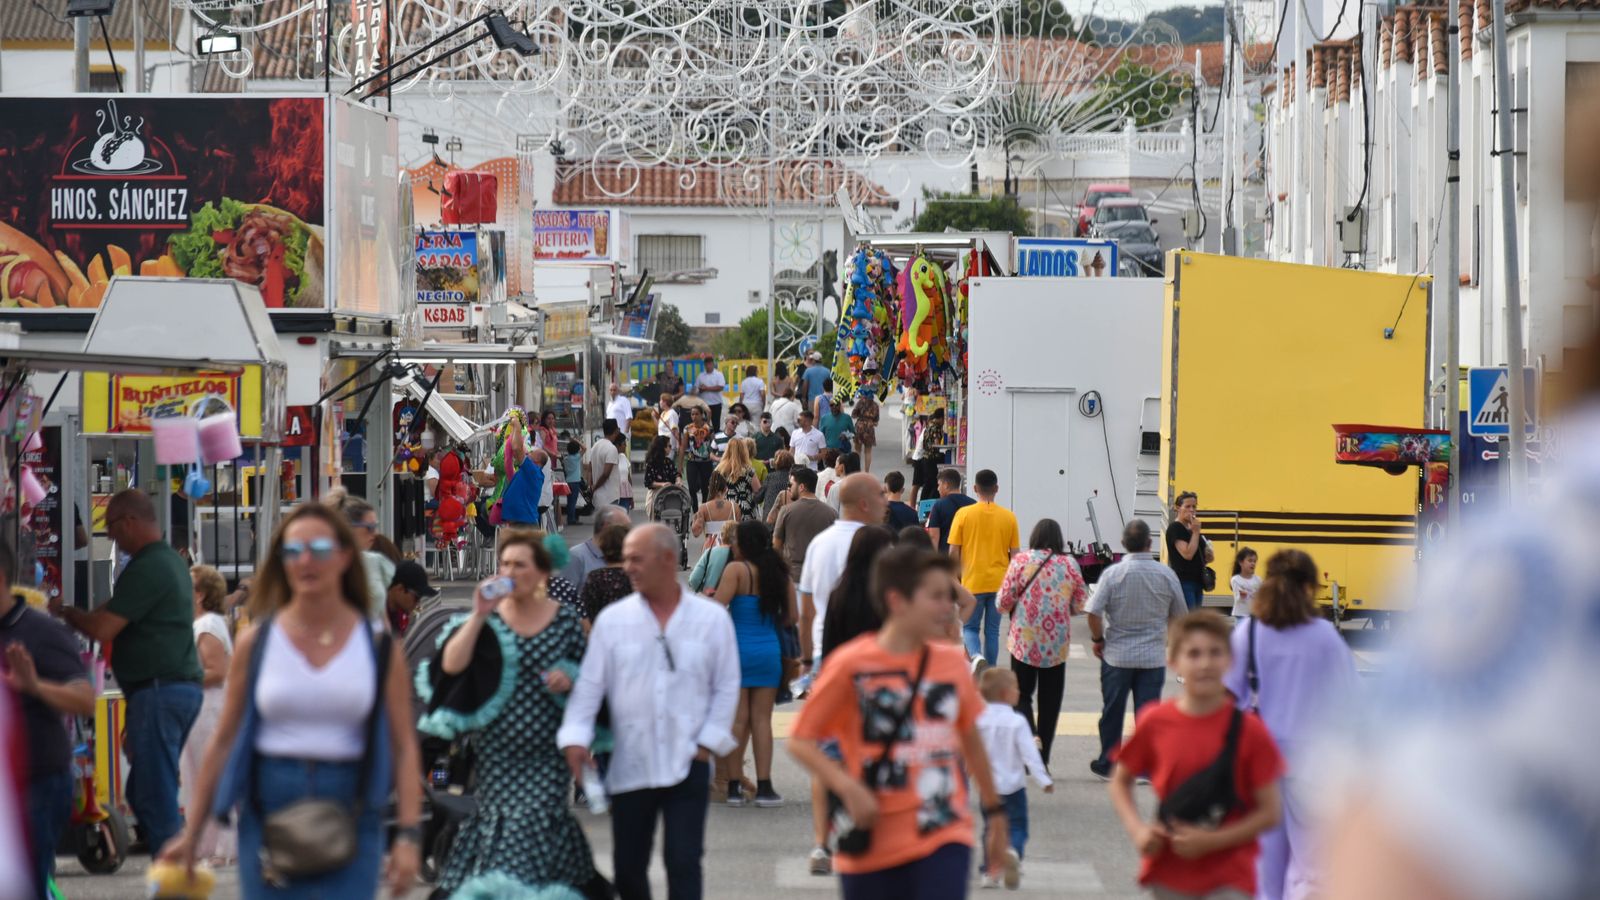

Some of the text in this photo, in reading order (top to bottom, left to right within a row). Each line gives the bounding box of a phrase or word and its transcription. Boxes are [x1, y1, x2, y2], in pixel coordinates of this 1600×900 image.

[354, 0, 367, 94] TATAS
[51, 181, 188, 220] HNOS. SÁNCHEZ
[577, 212, 609, 228] KEBAB
[1018, 249, 1079, 276] LADOS
[424, 308, 465, 322] KEBAB
[122, 380, 228, 404] BUÑUELOS
[1462, 492, 1476, 504] 01
